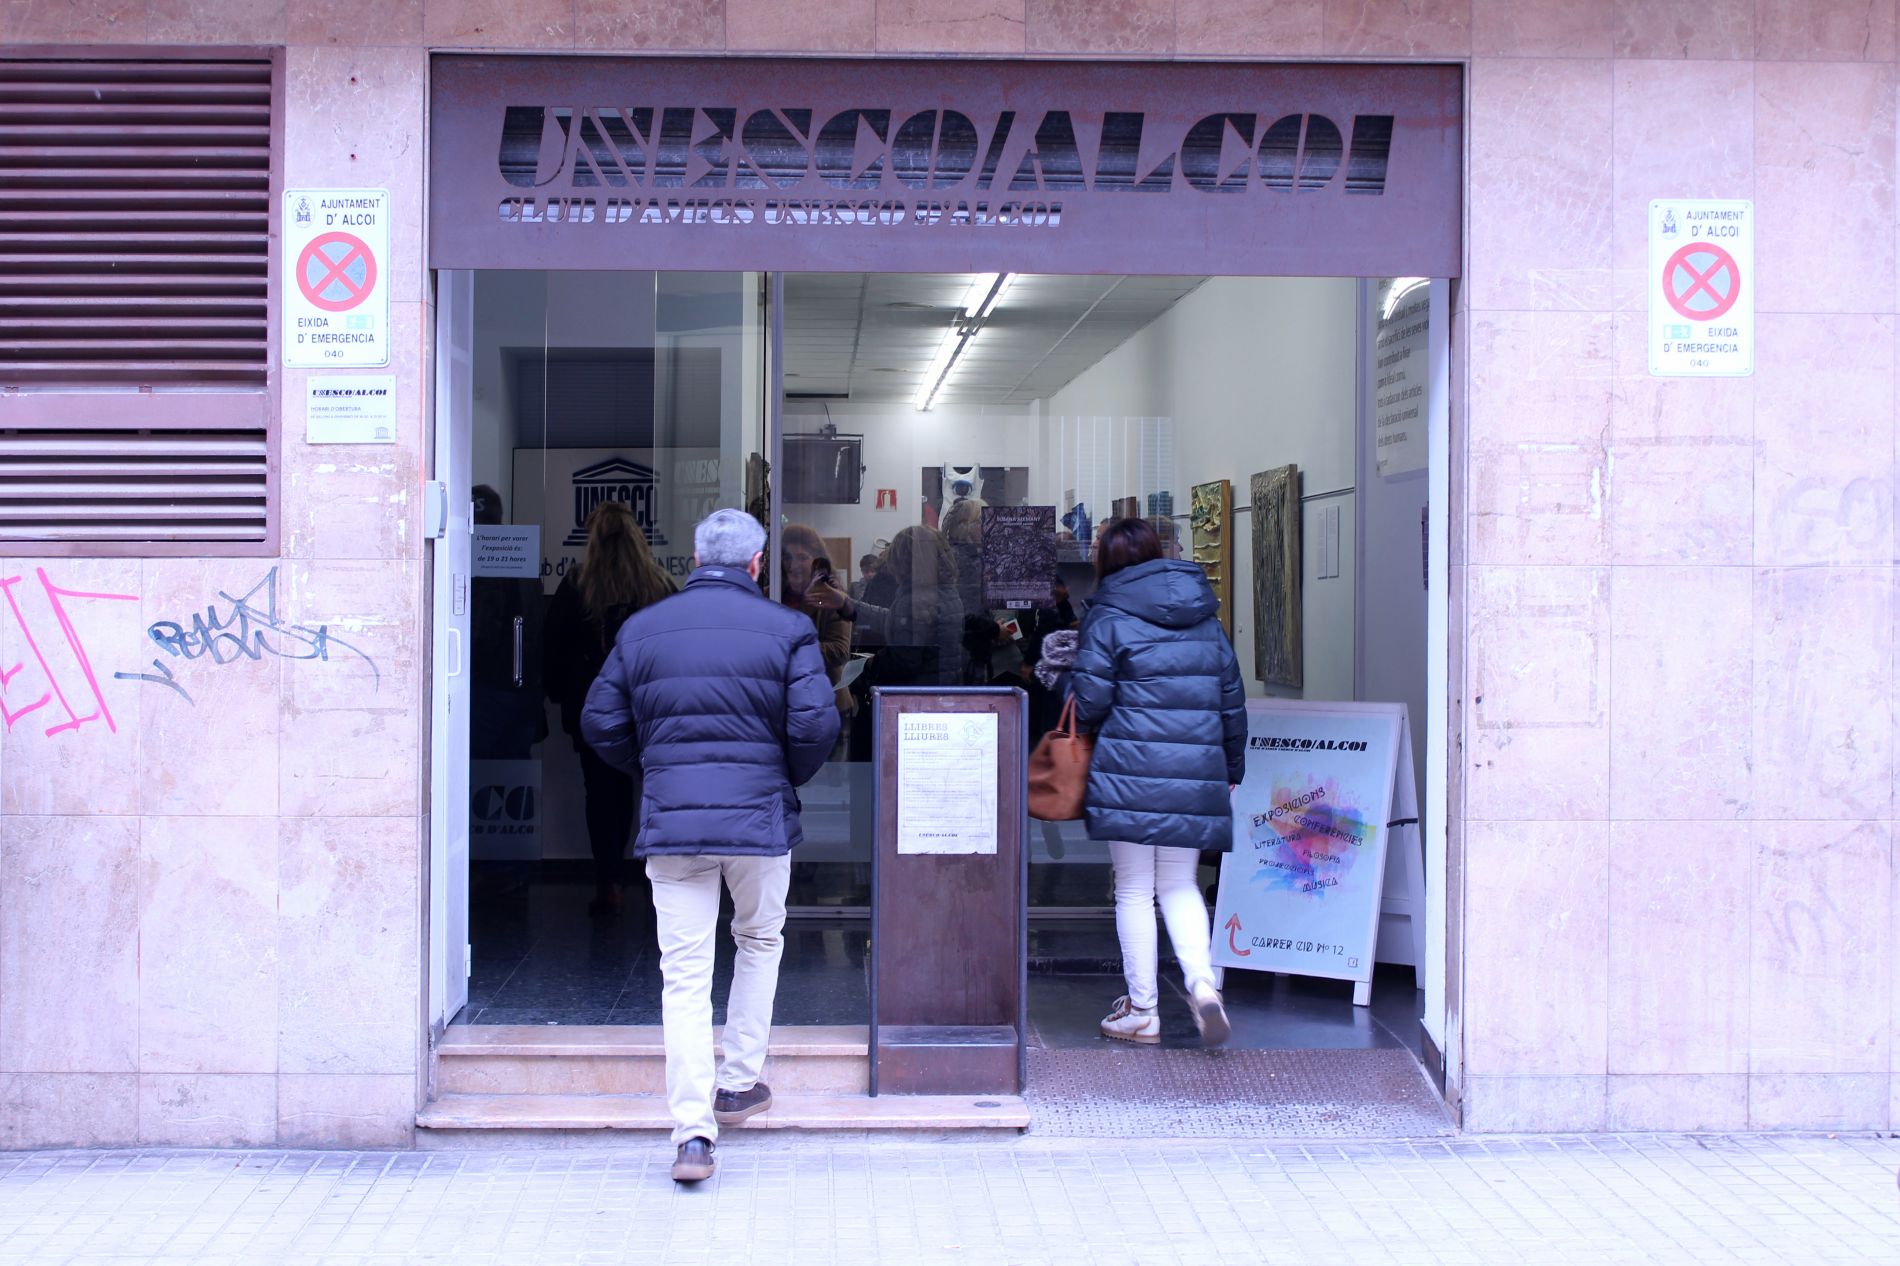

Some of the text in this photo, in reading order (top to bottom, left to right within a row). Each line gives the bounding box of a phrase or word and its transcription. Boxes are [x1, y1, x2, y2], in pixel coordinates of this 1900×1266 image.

[499, 105, 1394, 196] UNESCO/ALCOI
[320, 199, 381, 210] AJUNTAMENT
[499, 197, 1063, 227] CLUB D'AMICS UNESCO D'ALCOI
[1686, 211, 1744, 221] AJUNTAMENT
[342, 213, 376, 226] ALCOI
[1707, 225, 1739, 237] ALCOI
[297, 317, 329, 328] EIXIDA
[1708, 327, 1738, 337] EIXIDA
[311, 333, 375, 344] EMERGENCIA
[1677, 343, 1738, 353] EMERGENCIA
[324, 350, 344, 358] 040
[904, 733, 949, 741] LLIURES
[1250, 736, 1368, 752] UNESCO/ALCOI
[1254, 832, 1301, 850] LITERATURA
[1251, 936, 1293, 950] CARRER
[1296, 940, 1313, 952] CID
[1333, 945, 1344, 956] 12
